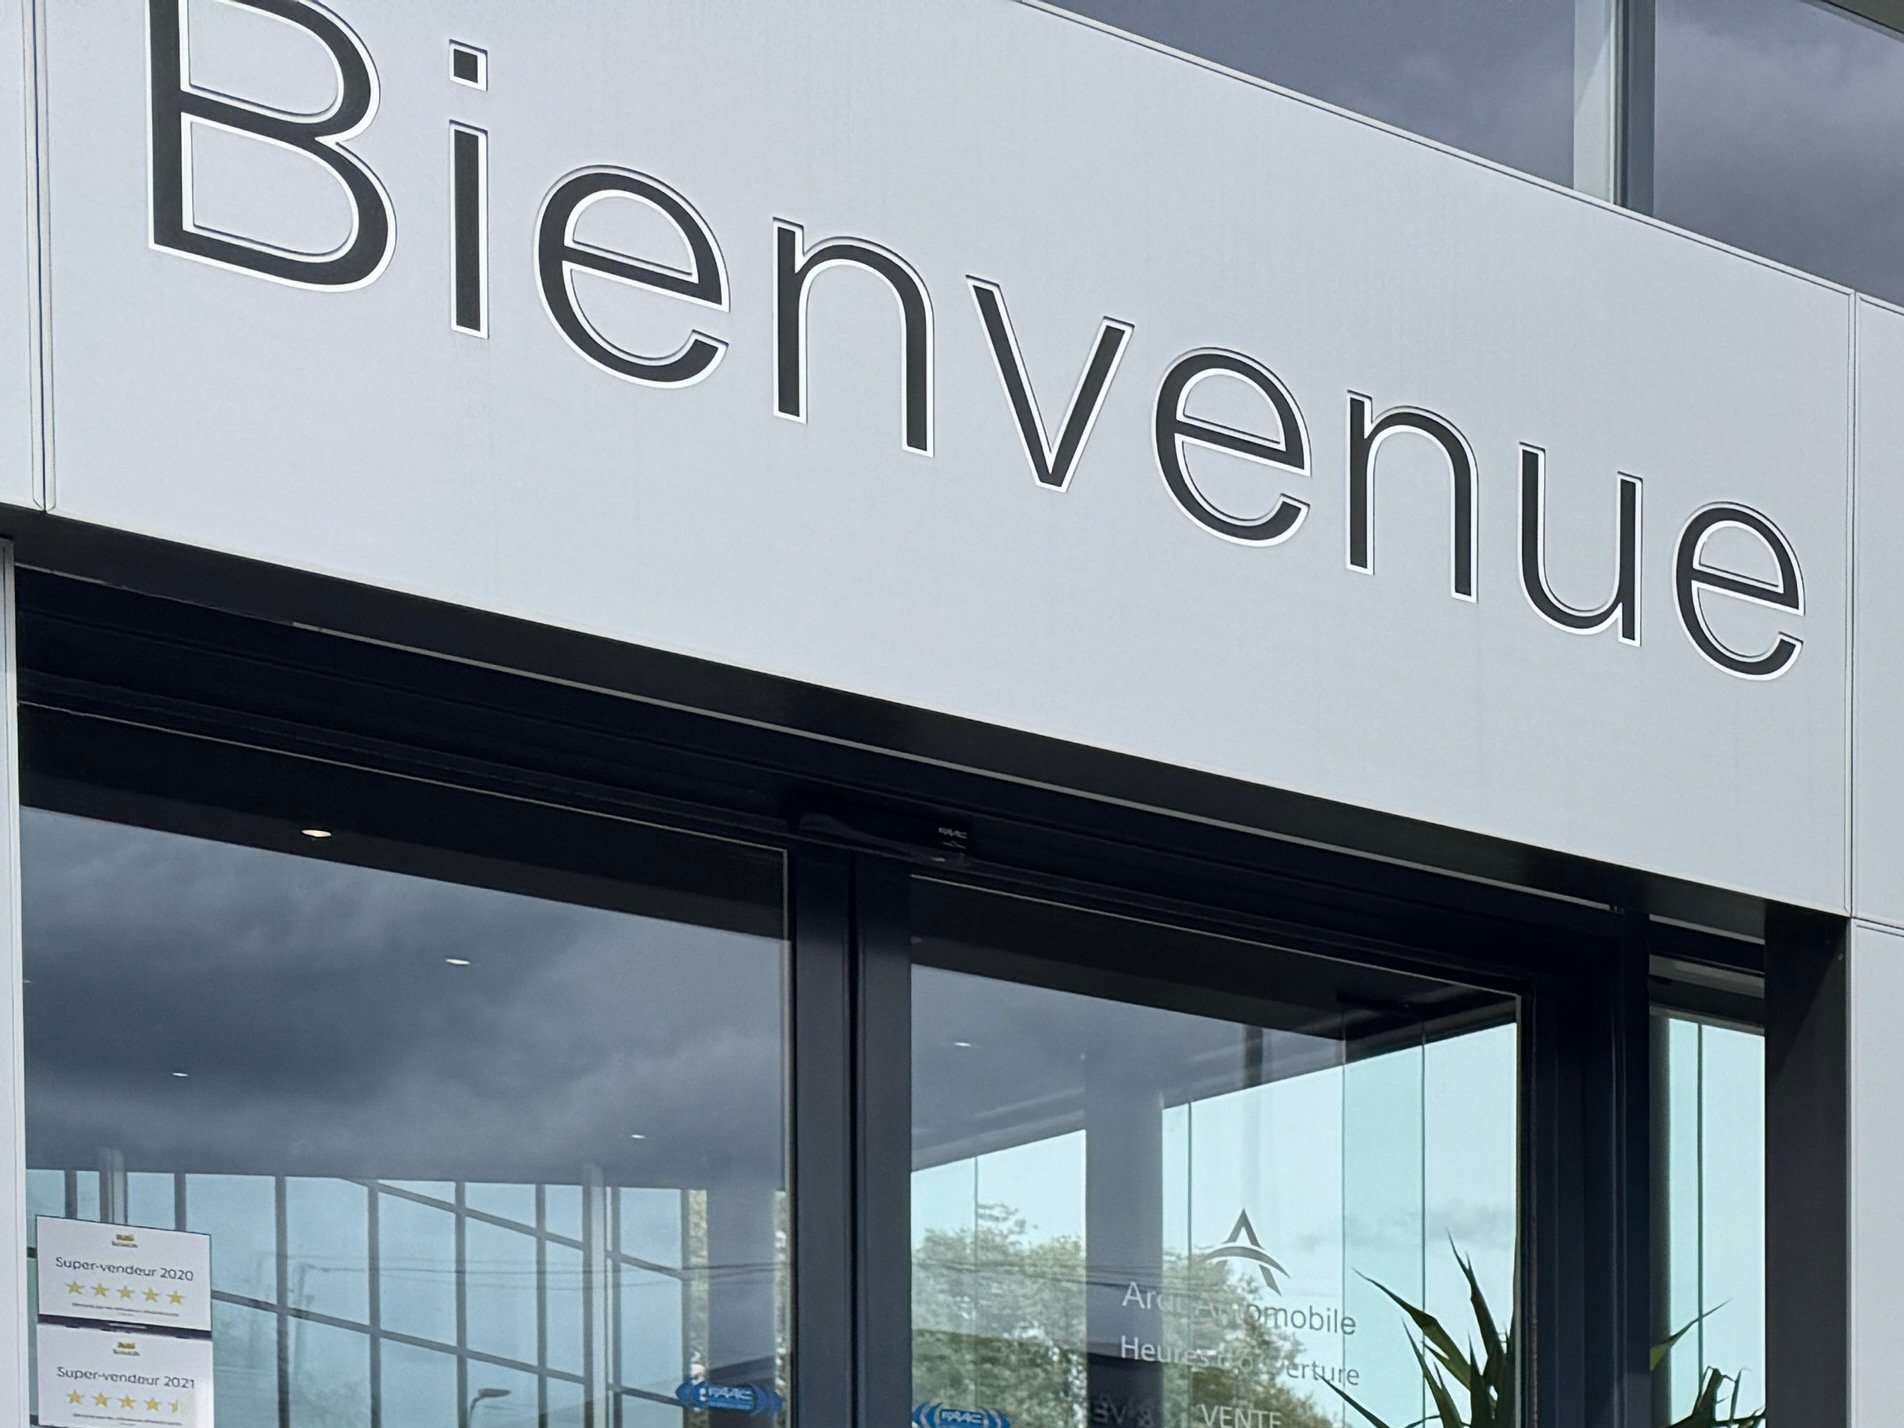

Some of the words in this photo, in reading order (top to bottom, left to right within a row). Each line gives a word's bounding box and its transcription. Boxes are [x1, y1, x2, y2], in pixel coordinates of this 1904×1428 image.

[149, 0, 1806, 680] Bienvenue
[56, 1256, 157, 1277] Super-vendeur
[160, 1267, 194, 1281] 2020
[1121, 1335, 1209, 1365] Heures
[56, 1366, 160, 1386] Super-vendeur
[163, 1376, 195, 1389] 2021
